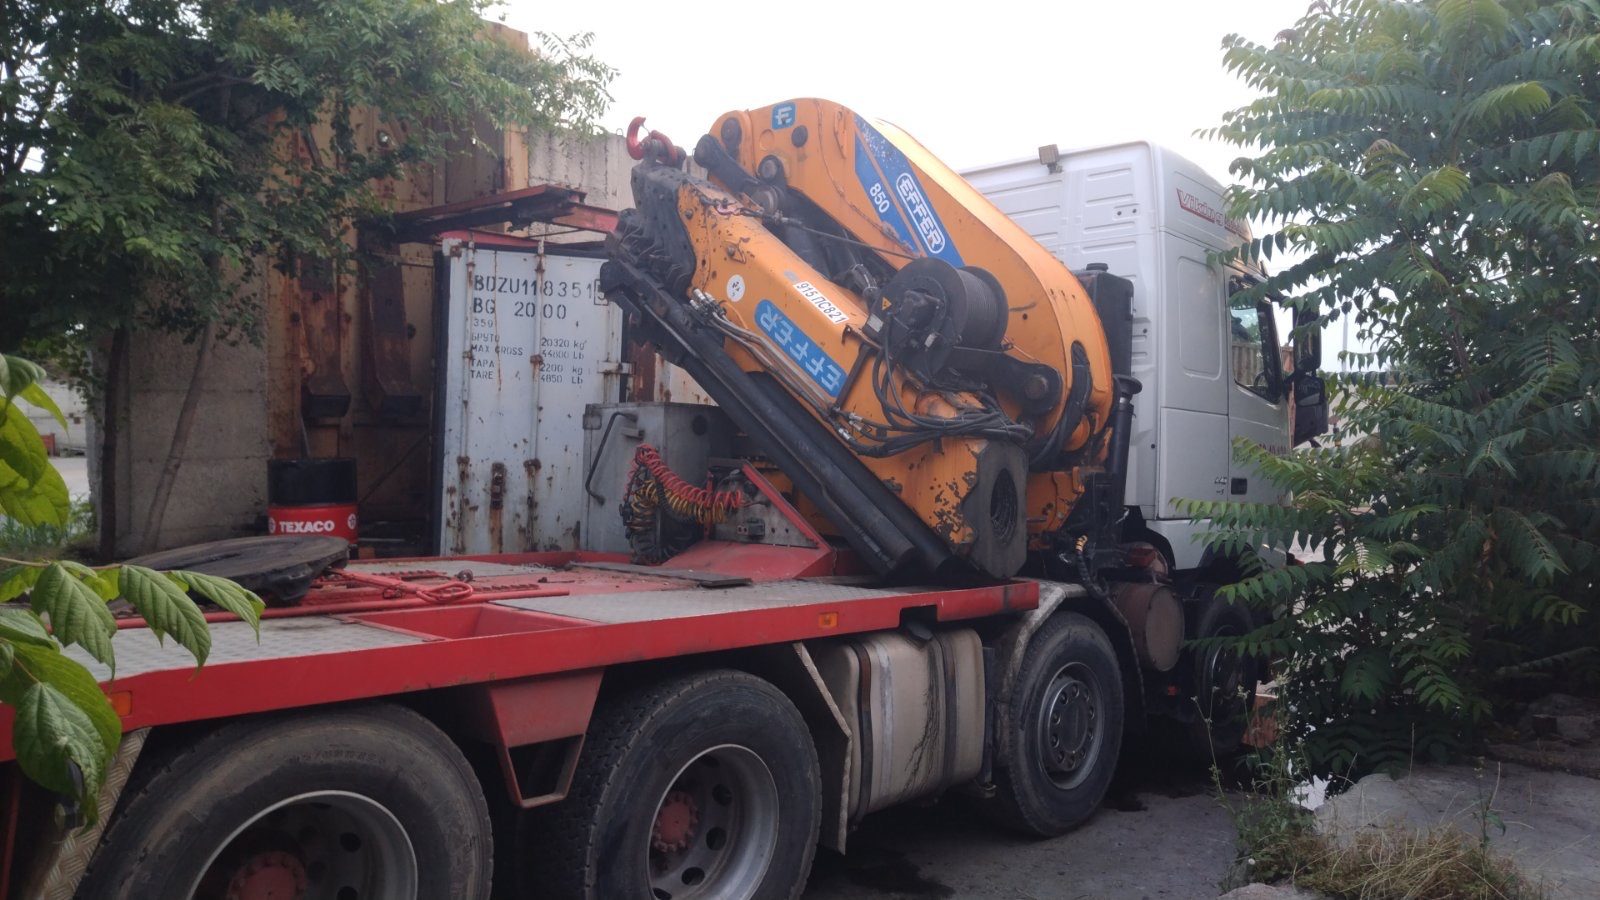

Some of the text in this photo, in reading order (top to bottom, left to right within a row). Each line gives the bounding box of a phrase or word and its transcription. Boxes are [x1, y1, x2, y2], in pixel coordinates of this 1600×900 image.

[869, 182, 890, 213] 850
[1176, 187, 1225, 226] Viking
[899, 178, 942, 249] EFFER
[473, 297, 496, 315] BG
[796, 282, 848, 323] 915ПС821
[470, 343, 490, 353] MAX
[541, 336, 570, 348] 20320
[573, 339, 585, 351] kg
[760, 303, 842, 392] EFFER
[470, 369, 494, 380] TARE
[539, 362, 564, 373] 2200
[572, 364, 583, 376] kg
[278, 520, 335, 533] TEXACO
